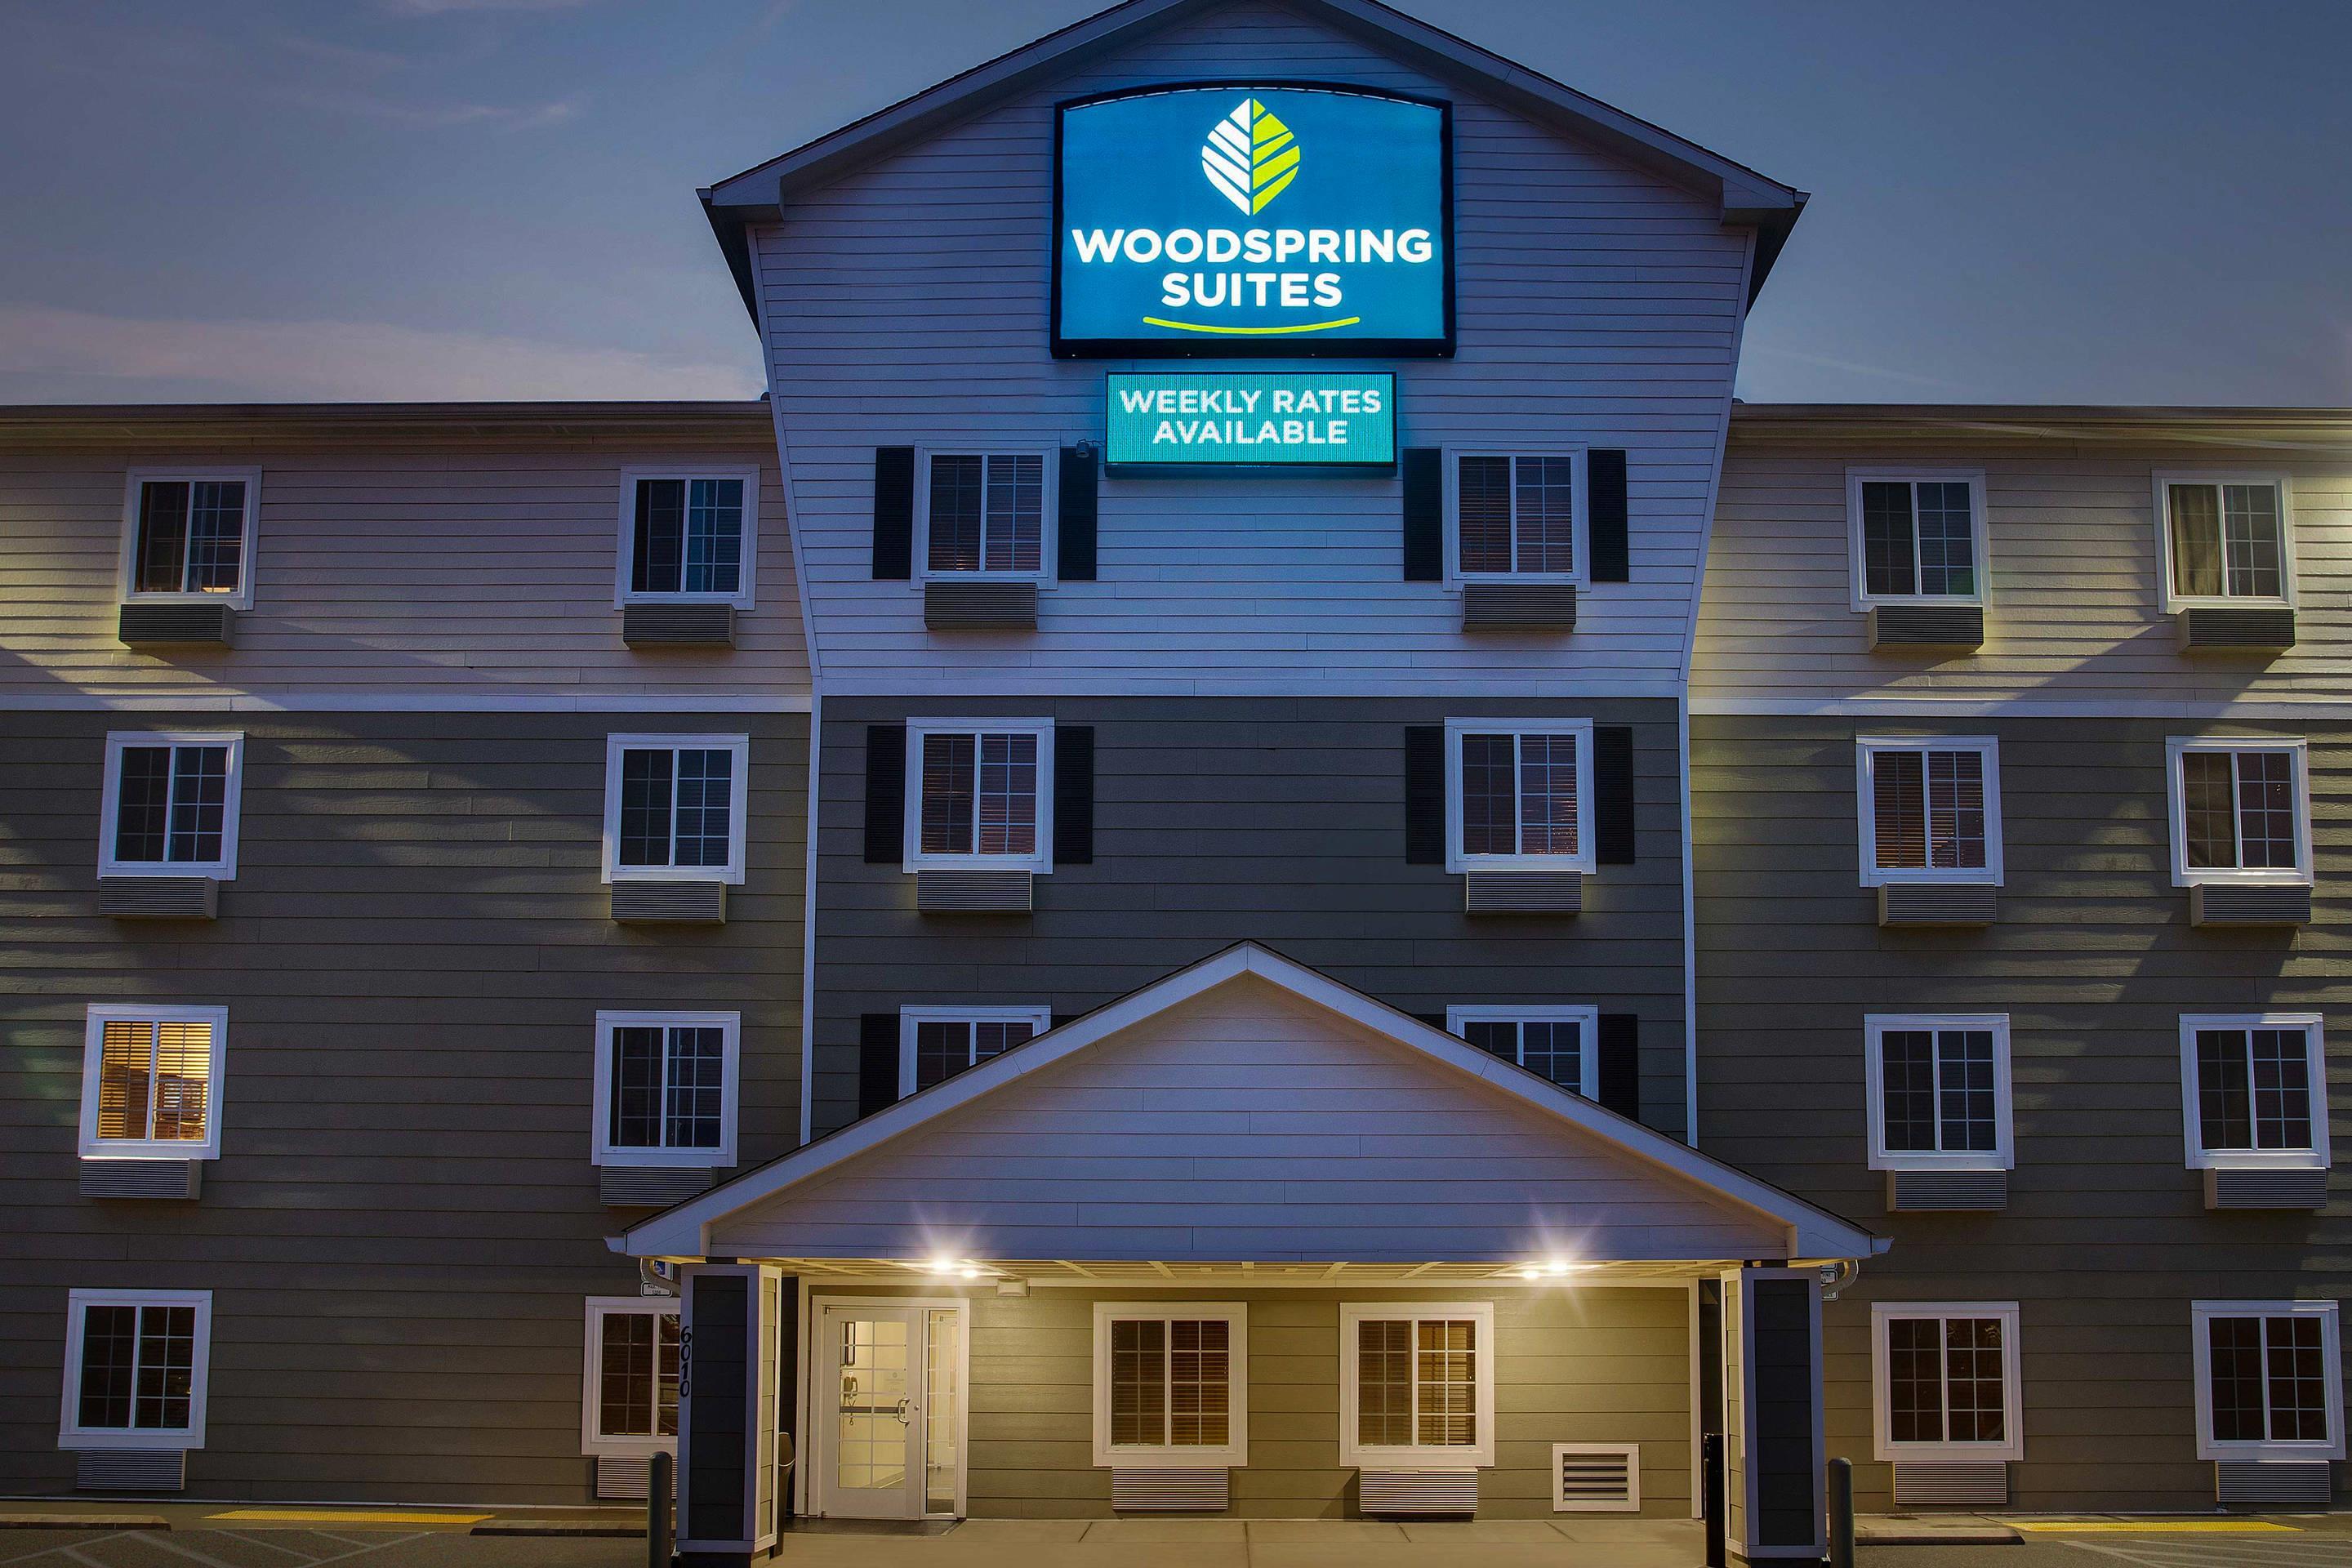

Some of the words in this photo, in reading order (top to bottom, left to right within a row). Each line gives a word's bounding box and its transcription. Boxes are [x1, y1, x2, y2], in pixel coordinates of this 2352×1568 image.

[1071, 228, 1432, 263] WOODSPRING
[1161, 272, 1343, 307] SUITES
[1119, 390, 1260, 413] WEEKLY
[1272, 390, 1382, 413] RATES
[1152, 420, 1348, 443] AVAILABLE
[679, 1325, 693, 1398] 6010
